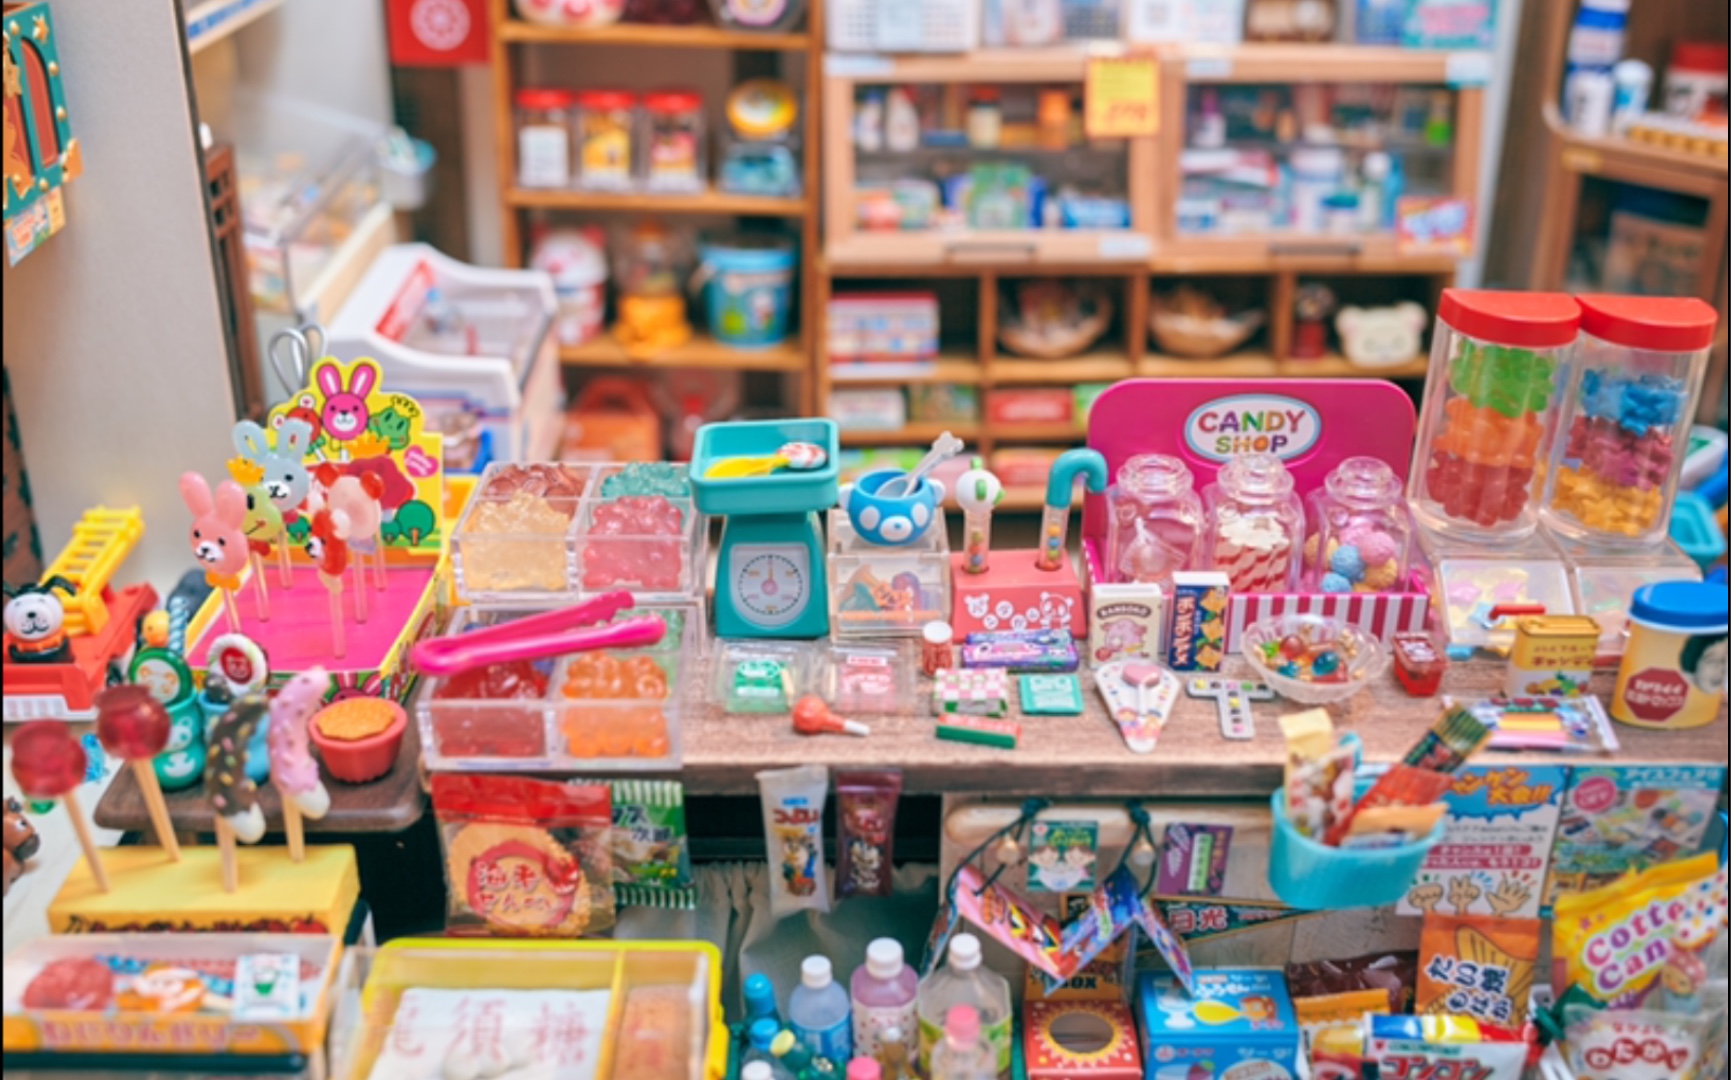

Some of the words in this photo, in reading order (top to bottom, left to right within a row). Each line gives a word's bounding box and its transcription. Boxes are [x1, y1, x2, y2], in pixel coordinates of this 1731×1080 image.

[1197, 409, 1306, 433] CANDY
[1215, 434, 1288, 454] SHOP
[1169, 906, 1228, 931] 日光
